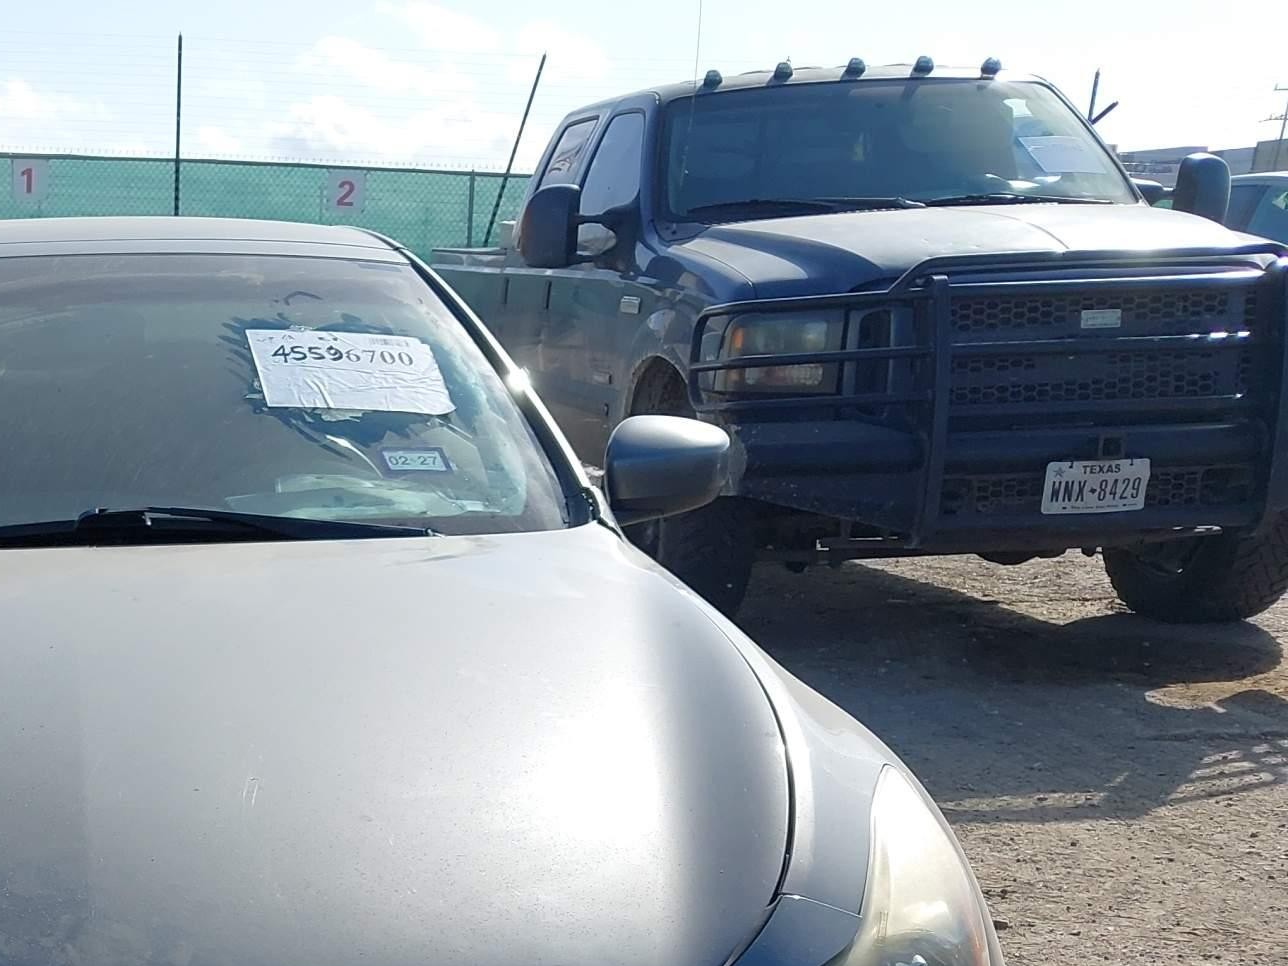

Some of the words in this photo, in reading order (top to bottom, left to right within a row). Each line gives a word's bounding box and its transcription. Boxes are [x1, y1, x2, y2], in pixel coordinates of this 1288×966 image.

[20, 167, 33, 194] 1
[336, 179, 355, 207] 2
[271, 344, 414, 367] 45596700
[1082, 463, 1122, 475] TEXAS
